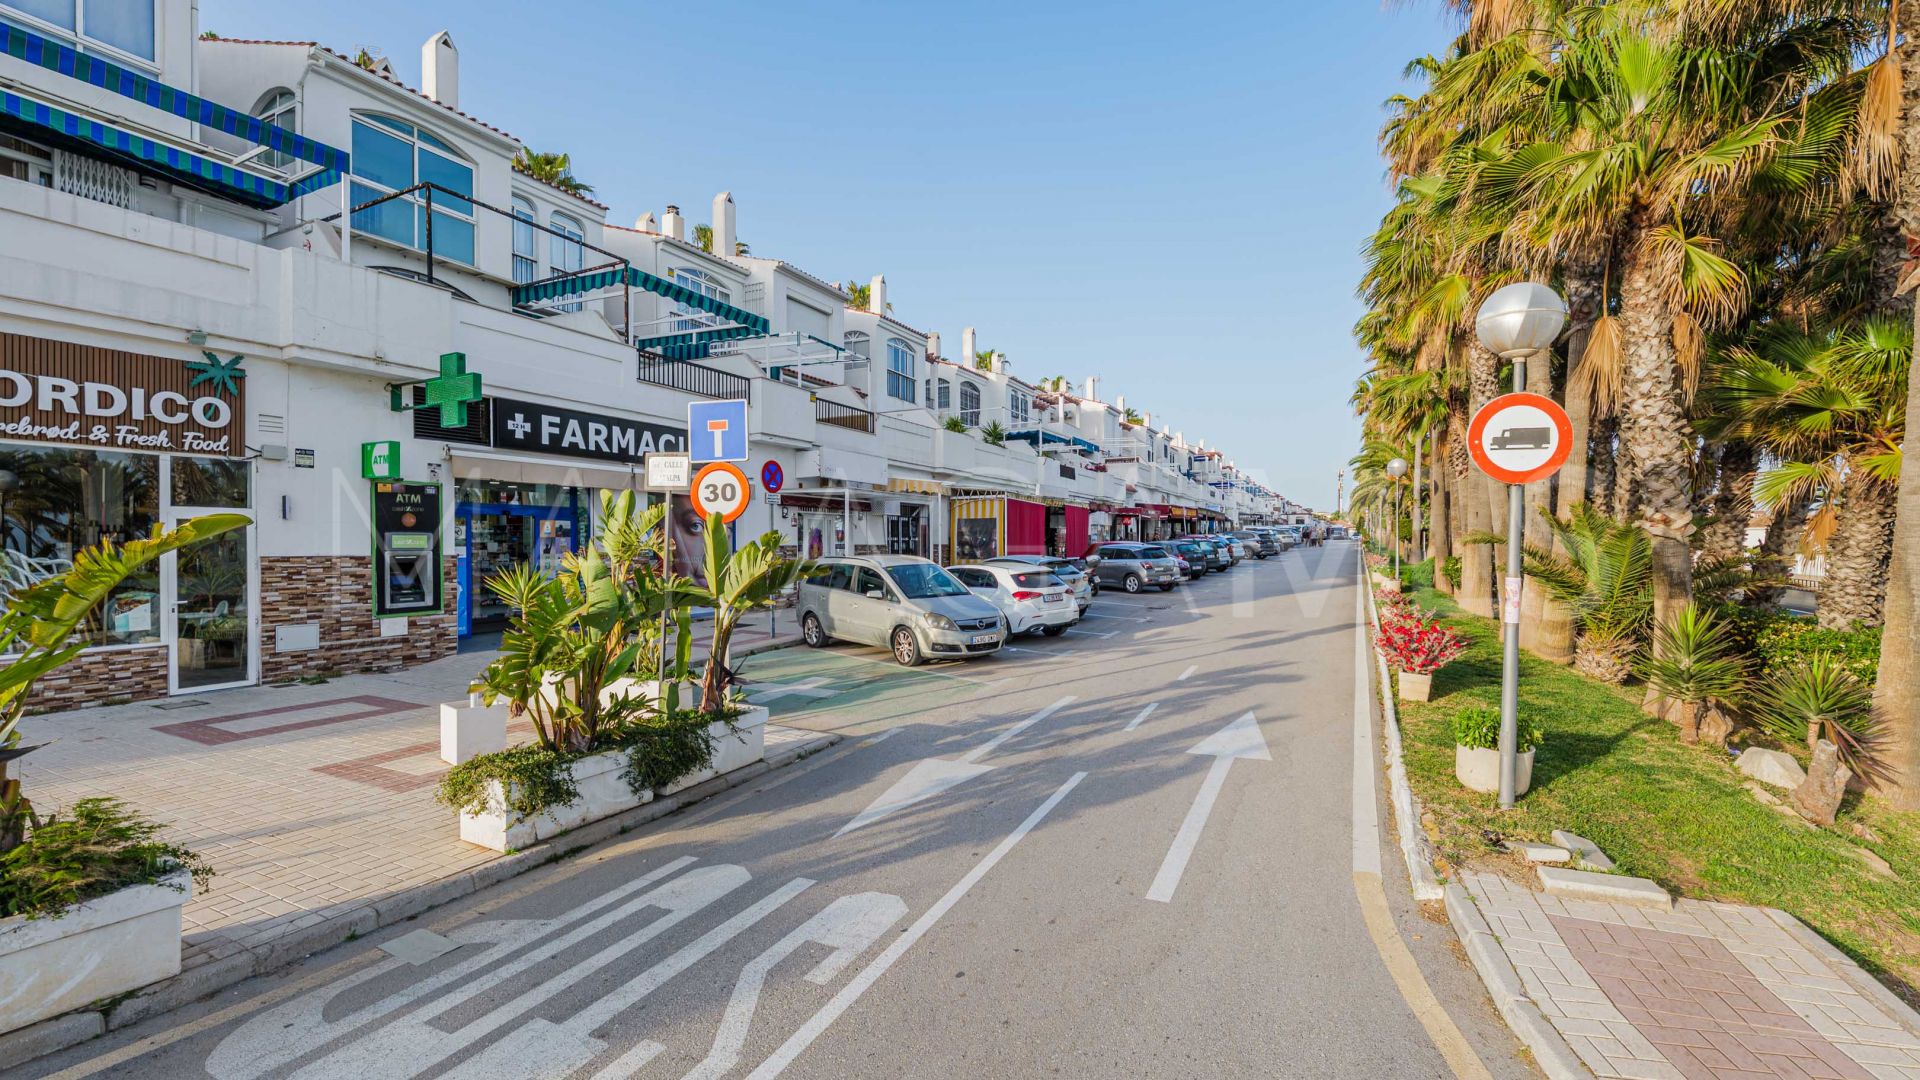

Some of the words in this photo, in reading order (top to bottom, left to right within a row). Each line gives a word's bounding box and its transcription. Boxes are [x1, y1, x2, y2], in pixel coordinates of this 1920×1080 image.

[88, 424, 110, 443] &
[115, 425, 172, 448] Fresh
[181, 431, 229, 452] Food
[541, 414, 685, 456] FARMACI
[395, 493, 421, 504] ATM
[704, 483, 737, 502] 30
